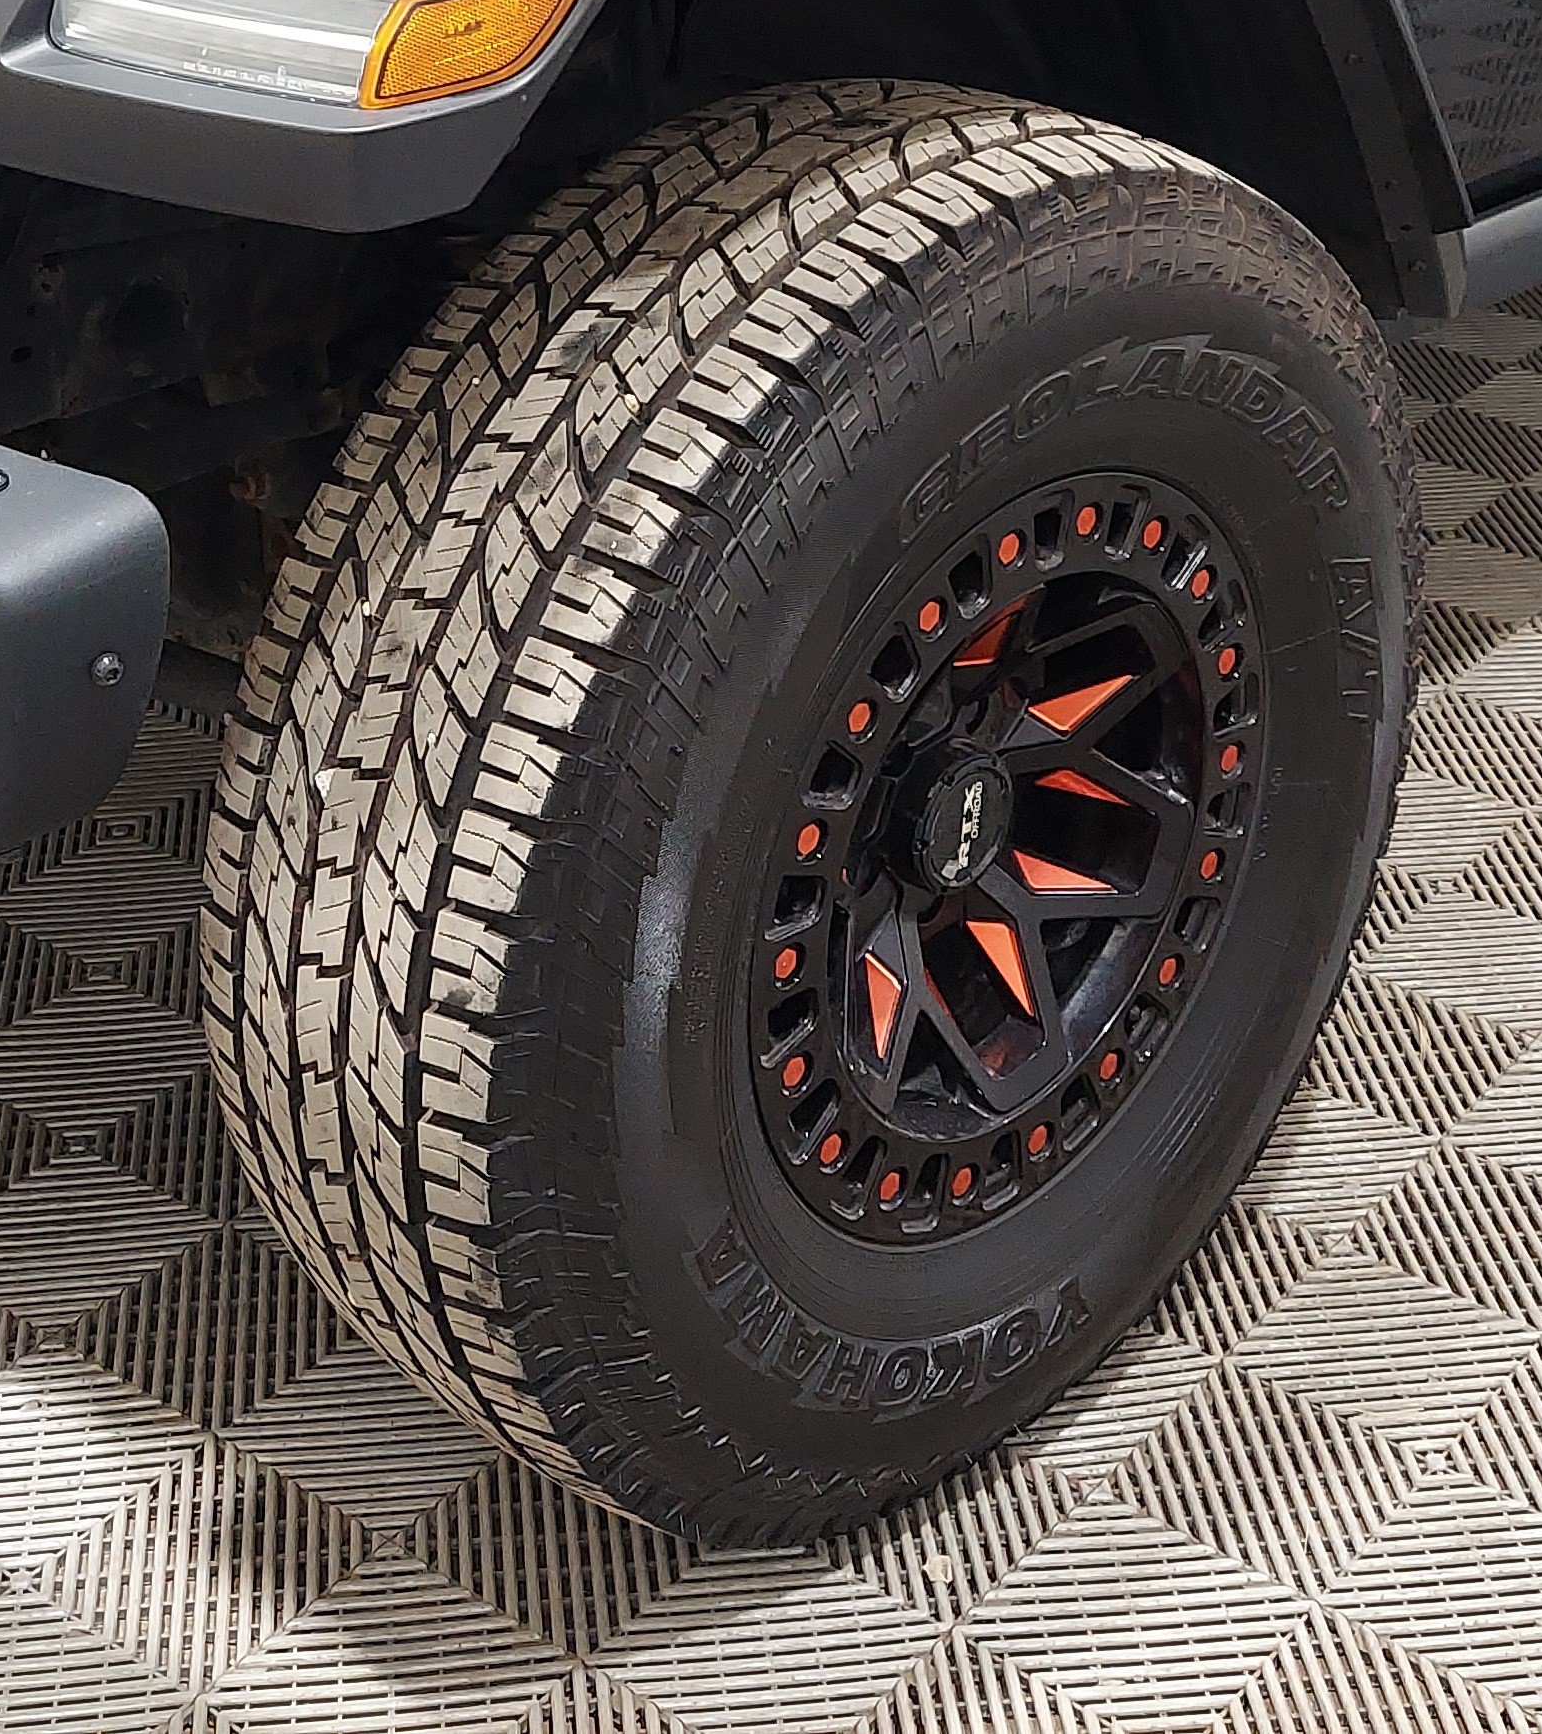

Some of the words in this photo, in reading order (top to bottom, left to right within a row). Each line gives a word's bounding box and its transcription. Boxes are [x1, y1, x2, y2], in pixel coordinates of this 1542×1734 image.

[899, 334, 1353, 545] GEOLANDAR
[958, 784, 977, 870] RTX
[971, 781, 983, 839] OFFROAD
[683, 1207, 1093, 1424] YOKOHAMA
